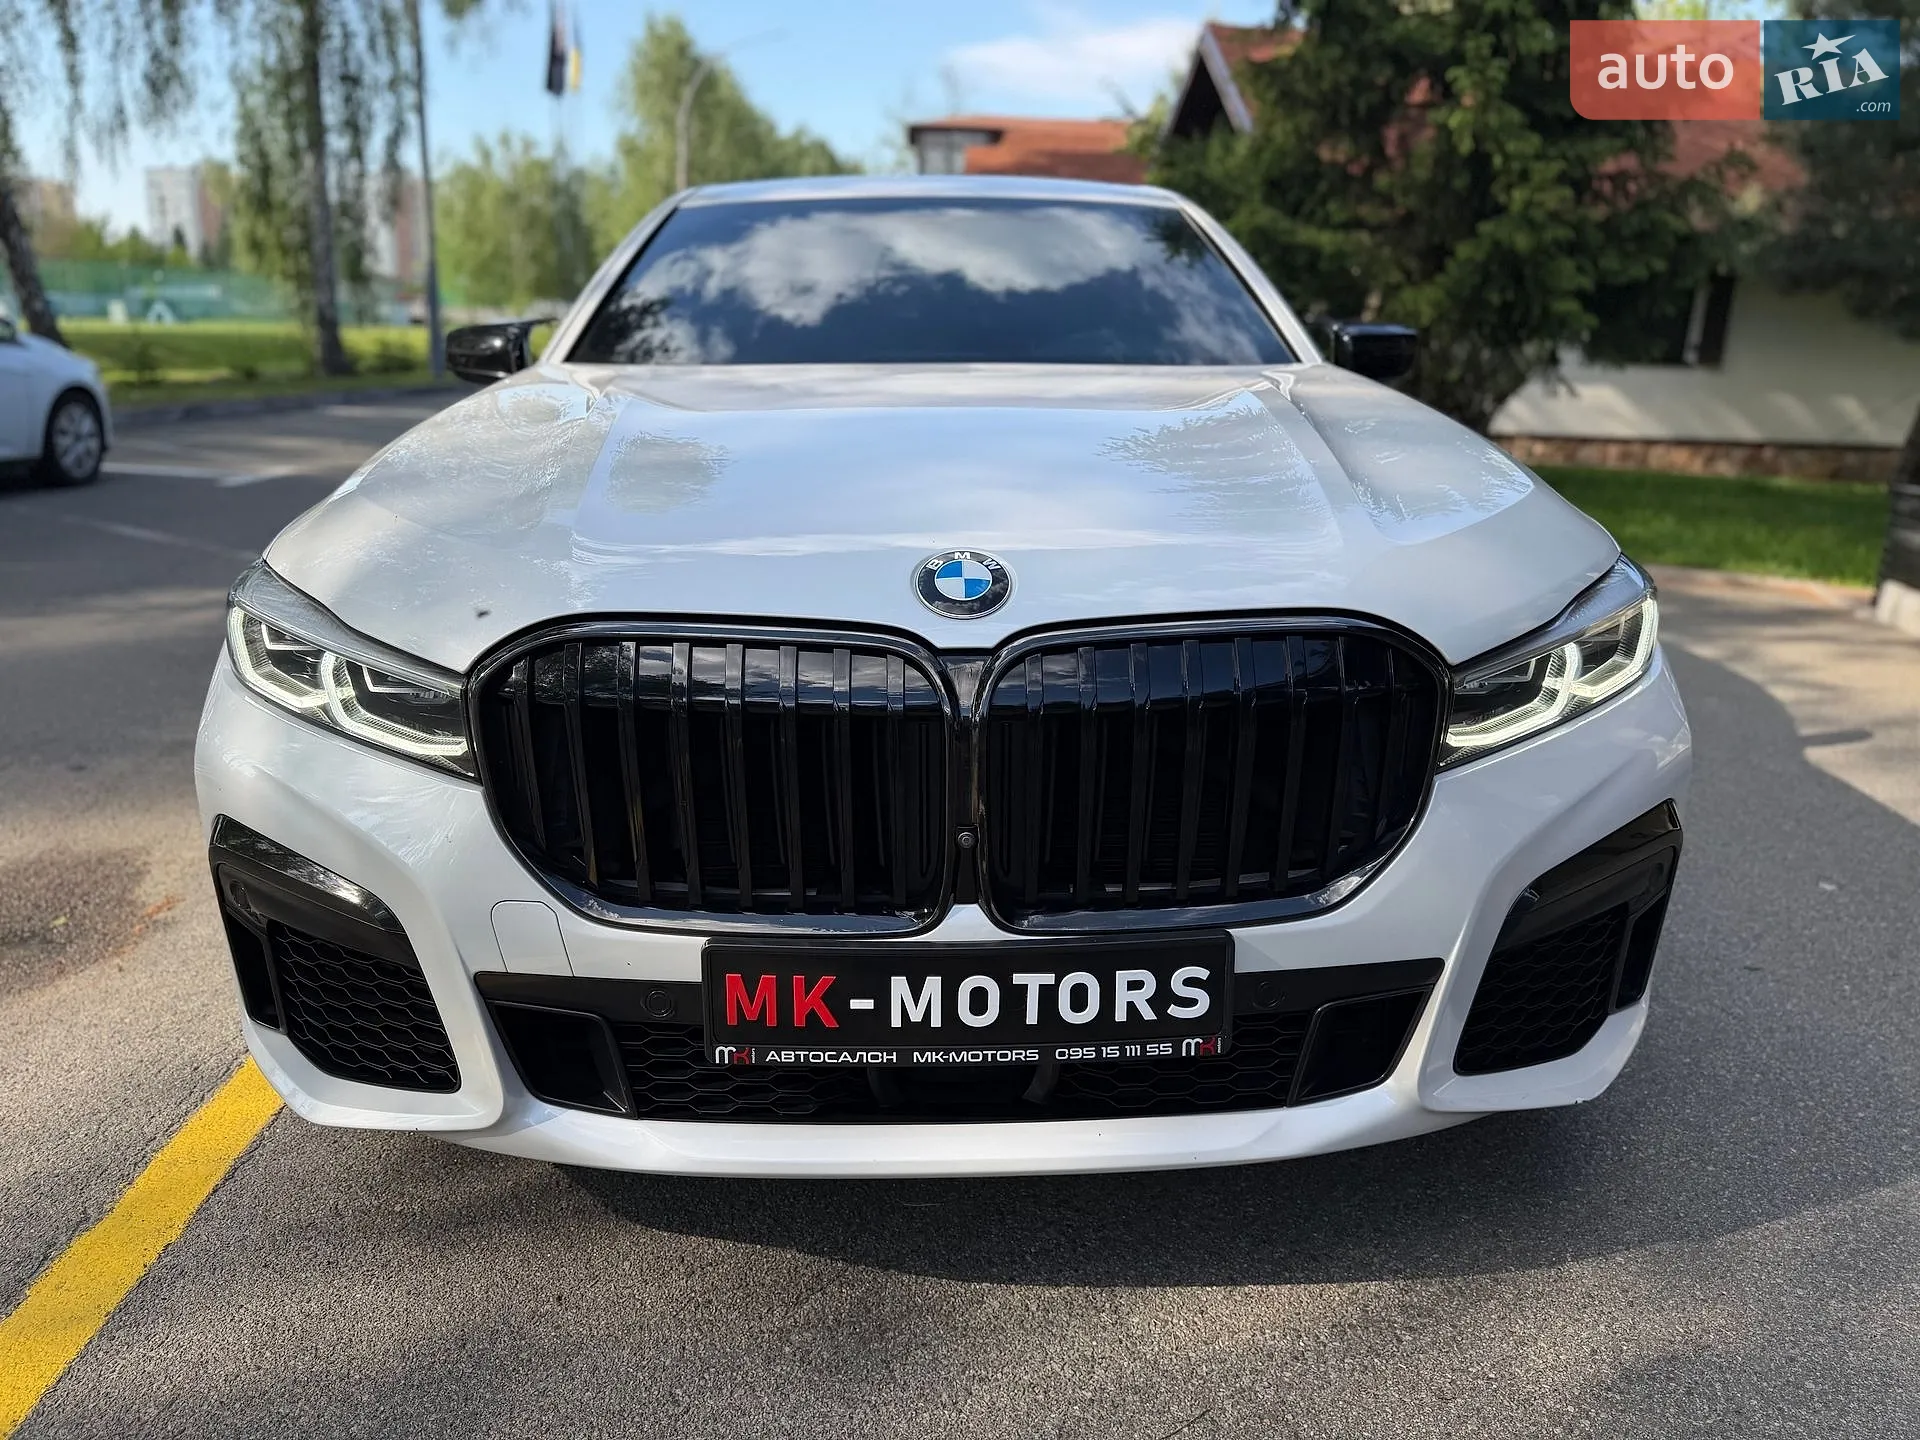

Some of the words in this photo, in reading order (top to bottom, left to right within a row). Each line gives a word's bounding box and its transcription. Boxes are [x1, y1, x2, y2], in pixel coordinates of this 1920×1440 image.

[926, 551, 1001, 571] BMW
[725, 965, 1211, 1029] MK-MOTORS
[765, 1050, 897, 1064] АВТОСАЛОН
[913, 1049, 1040, 1063] MK-MOTORS
[1055, 1046, 1096, 1060] 095
[1101, 1045, 1120, 1058] 15
[1125, 1044, 1141, 1057] 111
[1146, 1043, 1173, 1056] 55
